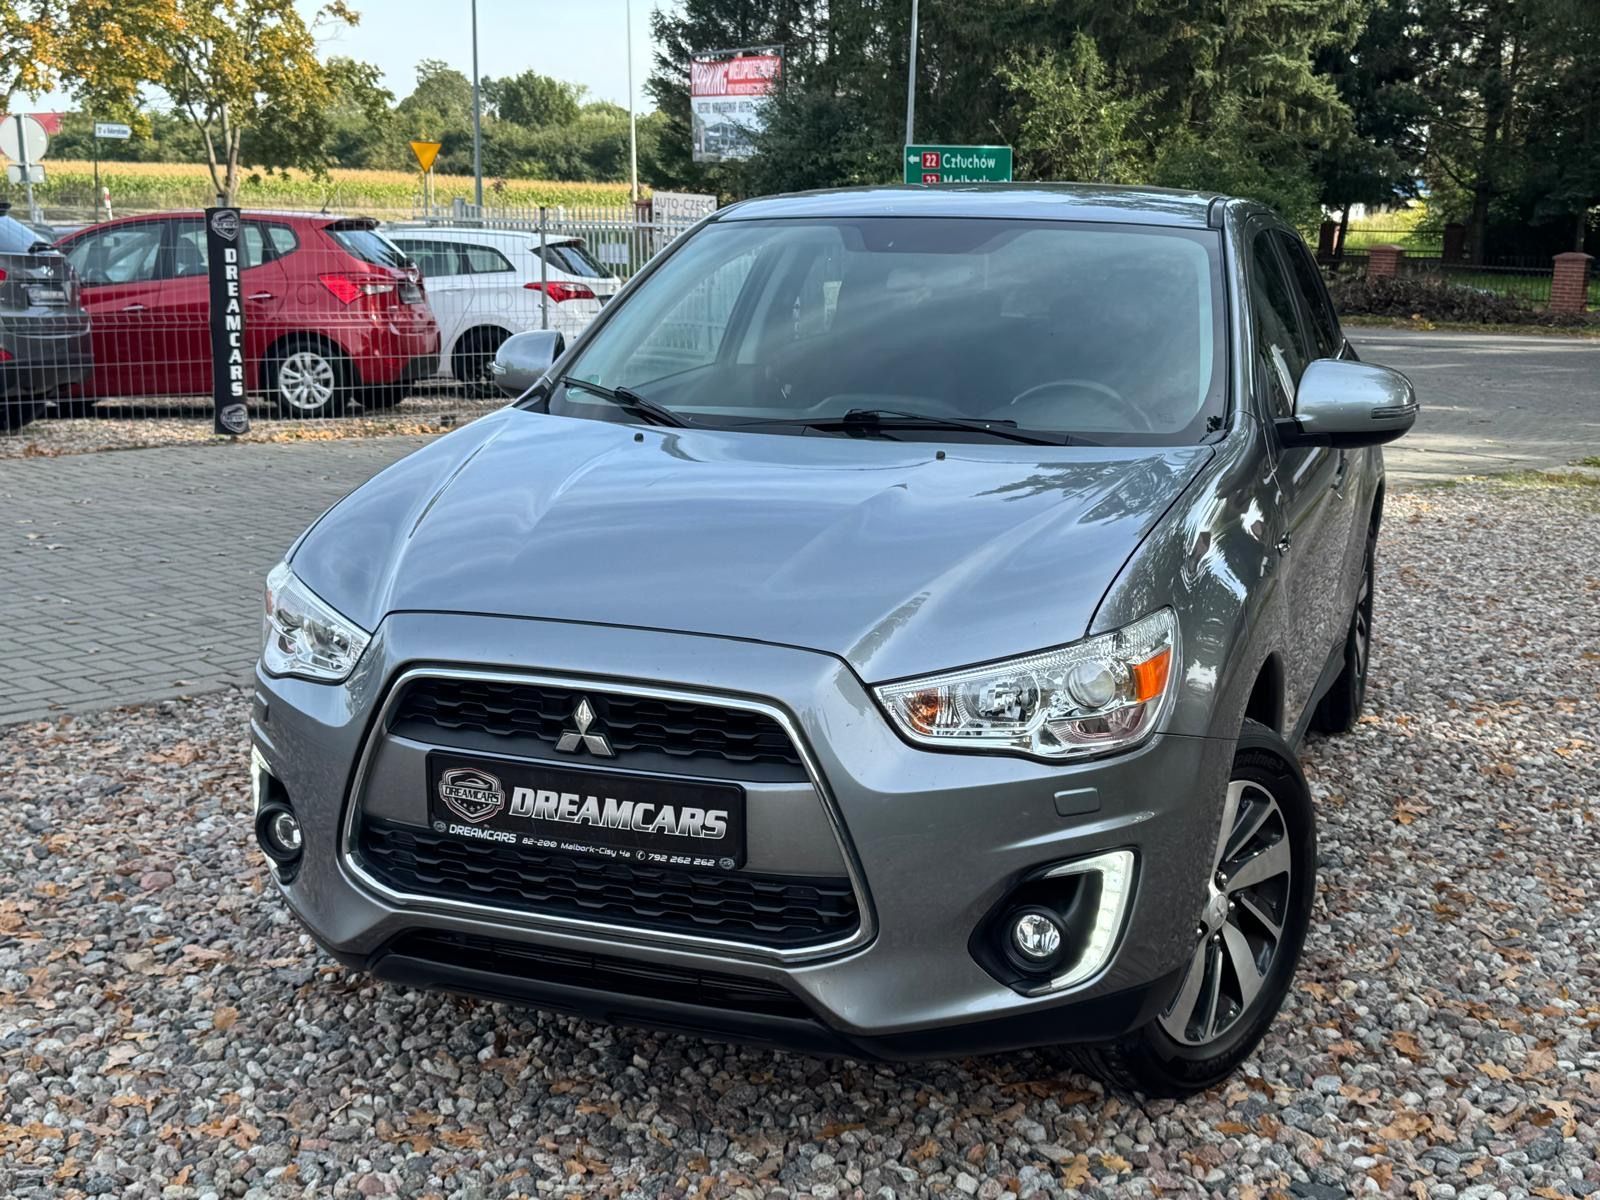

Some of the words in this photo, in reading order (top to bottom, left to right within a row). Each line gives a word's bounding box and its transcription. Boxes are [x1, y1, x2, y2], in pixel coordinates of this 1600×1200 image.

[925, 154, 937, 167] 22
[942, 153, 996, 169] Człuchów
[224, 248, 243, 396] DREAMCARS
[444, 785, 500, 803] DREAMCARS
[509, 786, 729, 840] DREAMCARS
[449, 823, 517, 844] DREAMCARS
[522, 837, 558, 848] 82-200
[648, 853, 667, 862] 792
[669, 855, 691, 865] 262
[693, 857, 715, 867] 262
